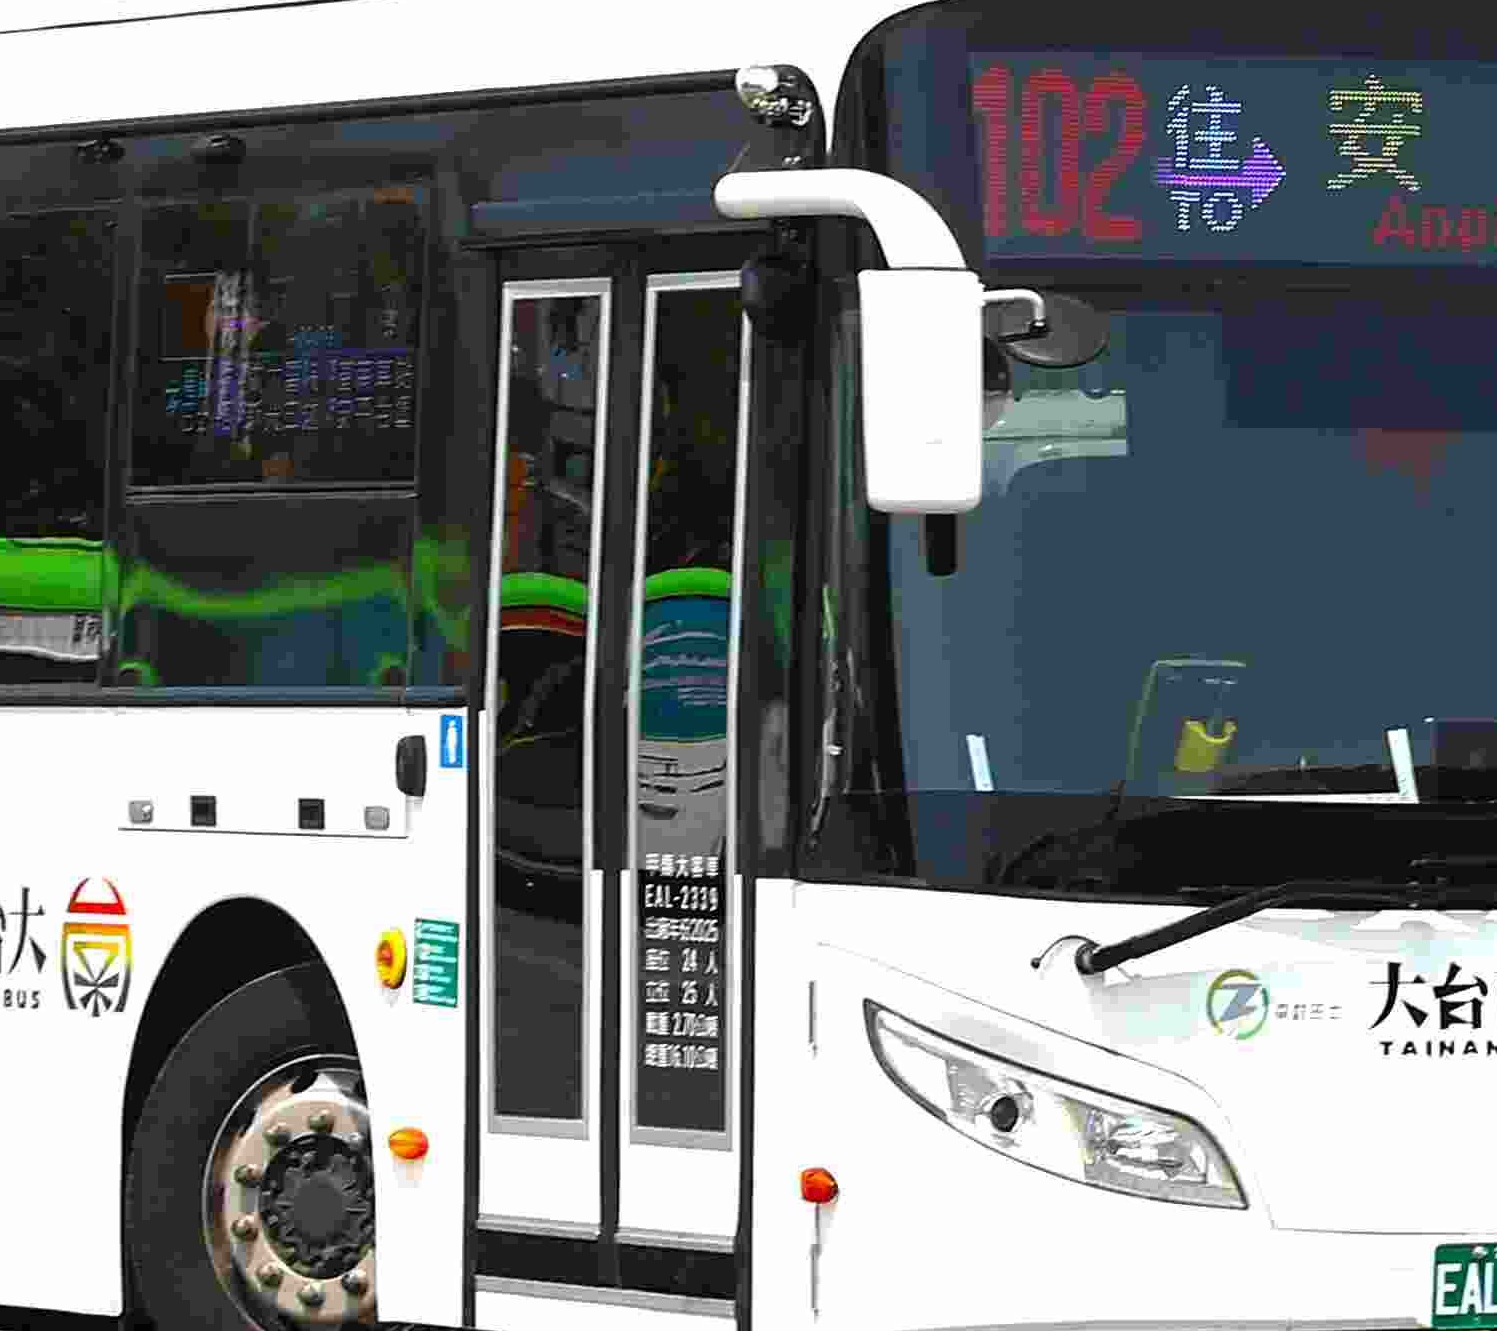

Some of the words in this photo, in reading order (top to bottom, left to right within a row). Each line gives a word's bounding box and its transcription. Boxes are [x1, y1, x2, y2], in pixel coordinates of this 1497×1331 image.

[970, 64, 1146, 240] 102
[1170, 188, 1243, 231] TO
[3, 988, 41, 1010] BUS
